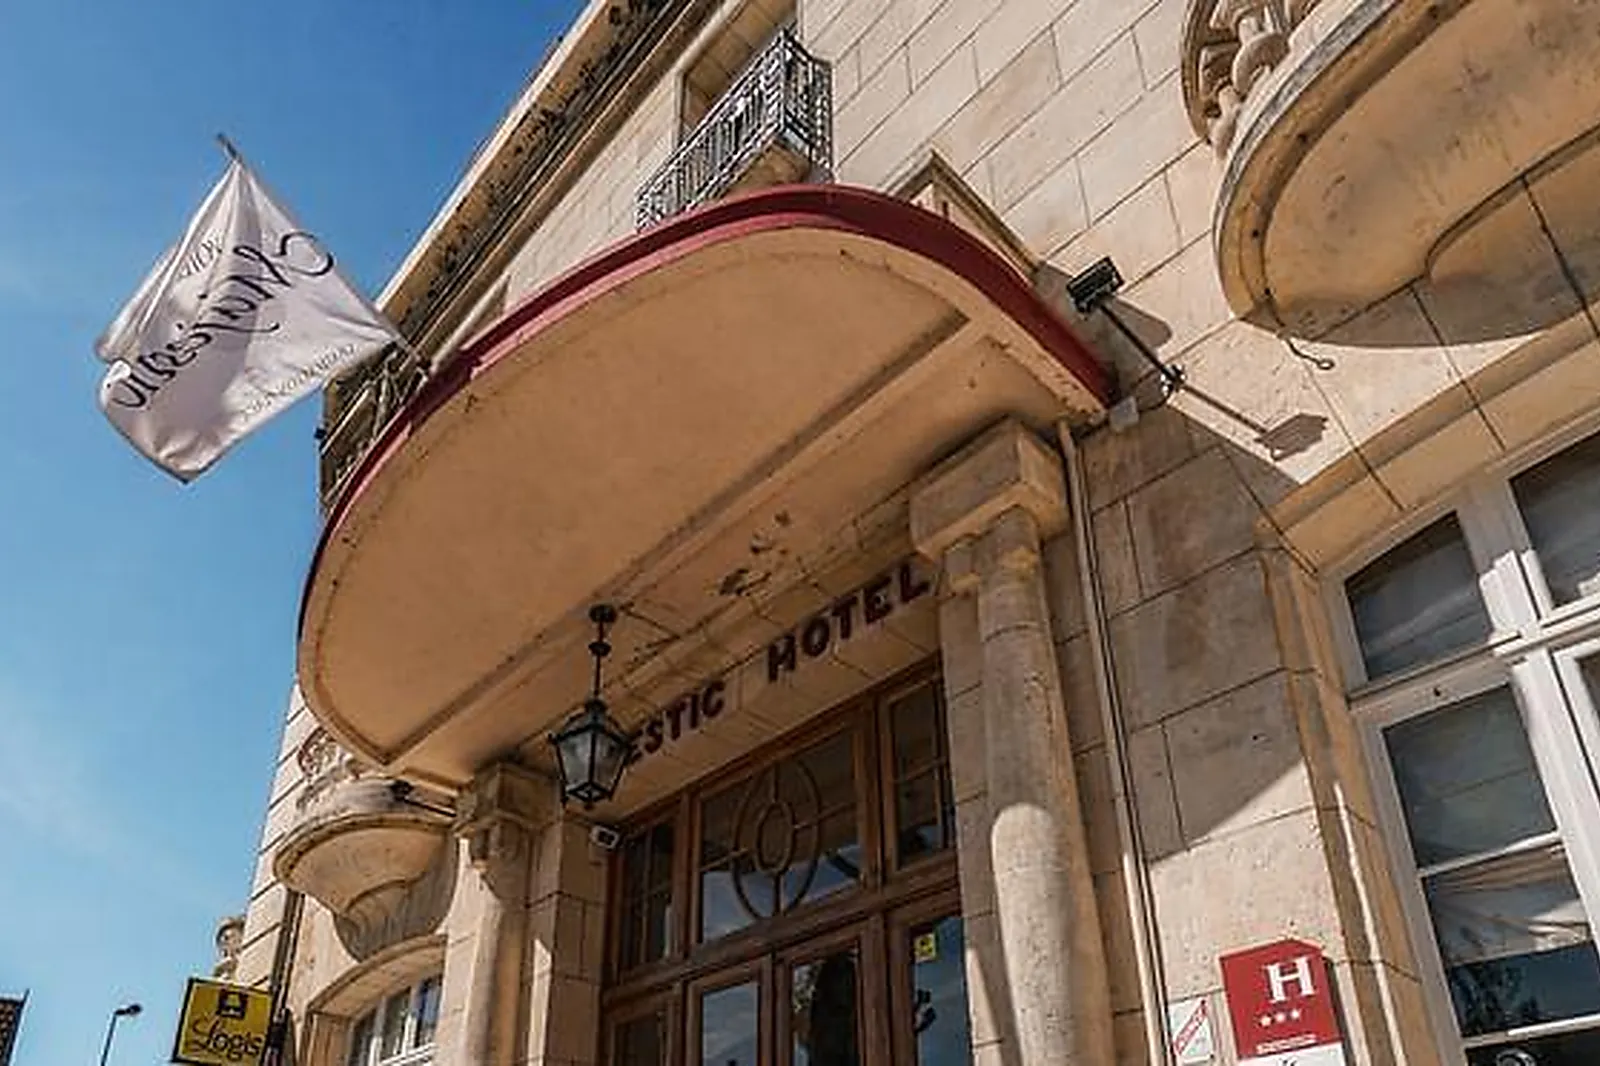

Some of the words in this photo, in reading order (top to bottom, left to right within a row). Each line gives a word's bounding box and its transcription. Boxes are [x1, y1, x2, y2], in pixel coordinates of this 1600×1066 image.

[623, 680, 727, 766] ESTIC
[767, 556, 930, 682] HOTEL
[1264, 956, 1318, 1004] H
